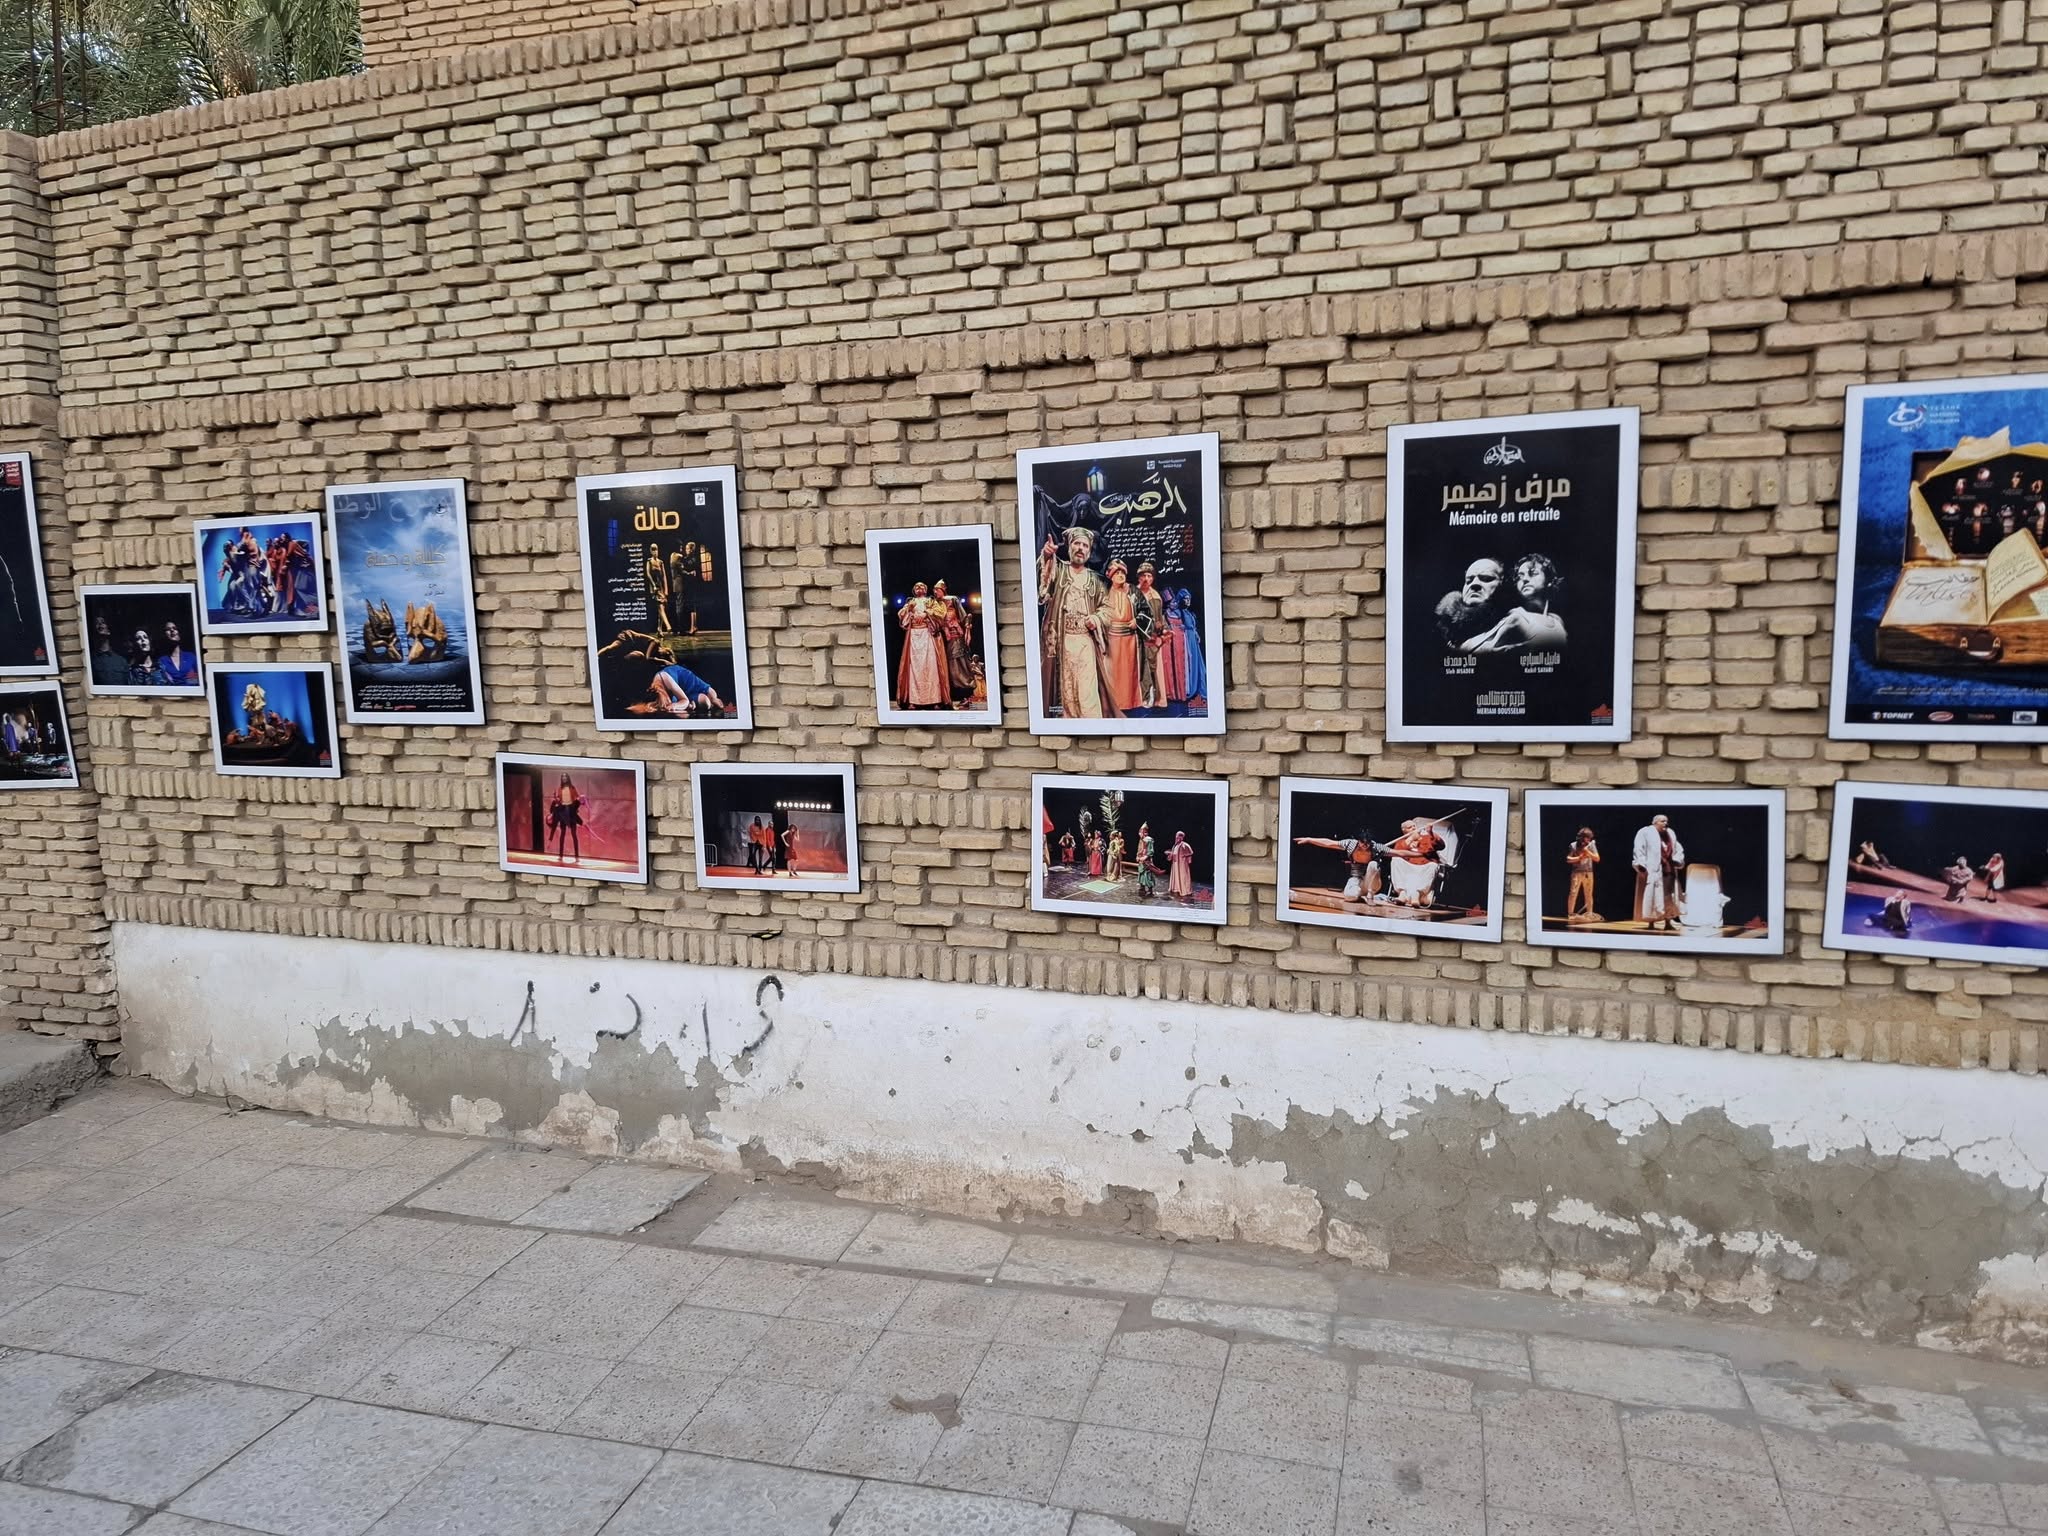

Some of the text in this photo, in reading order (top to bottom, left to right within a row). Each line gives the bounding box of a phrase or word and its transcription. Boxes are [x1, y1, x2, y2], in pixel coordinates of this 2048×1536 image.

[1441, 473, 1571, 512] مرض زهيمر
[634, 505, 680, 532] صالة
[1449, 506, 1560, 526] Mémoire en retraite
[1882, 711, 1915, 720] TOPNET
